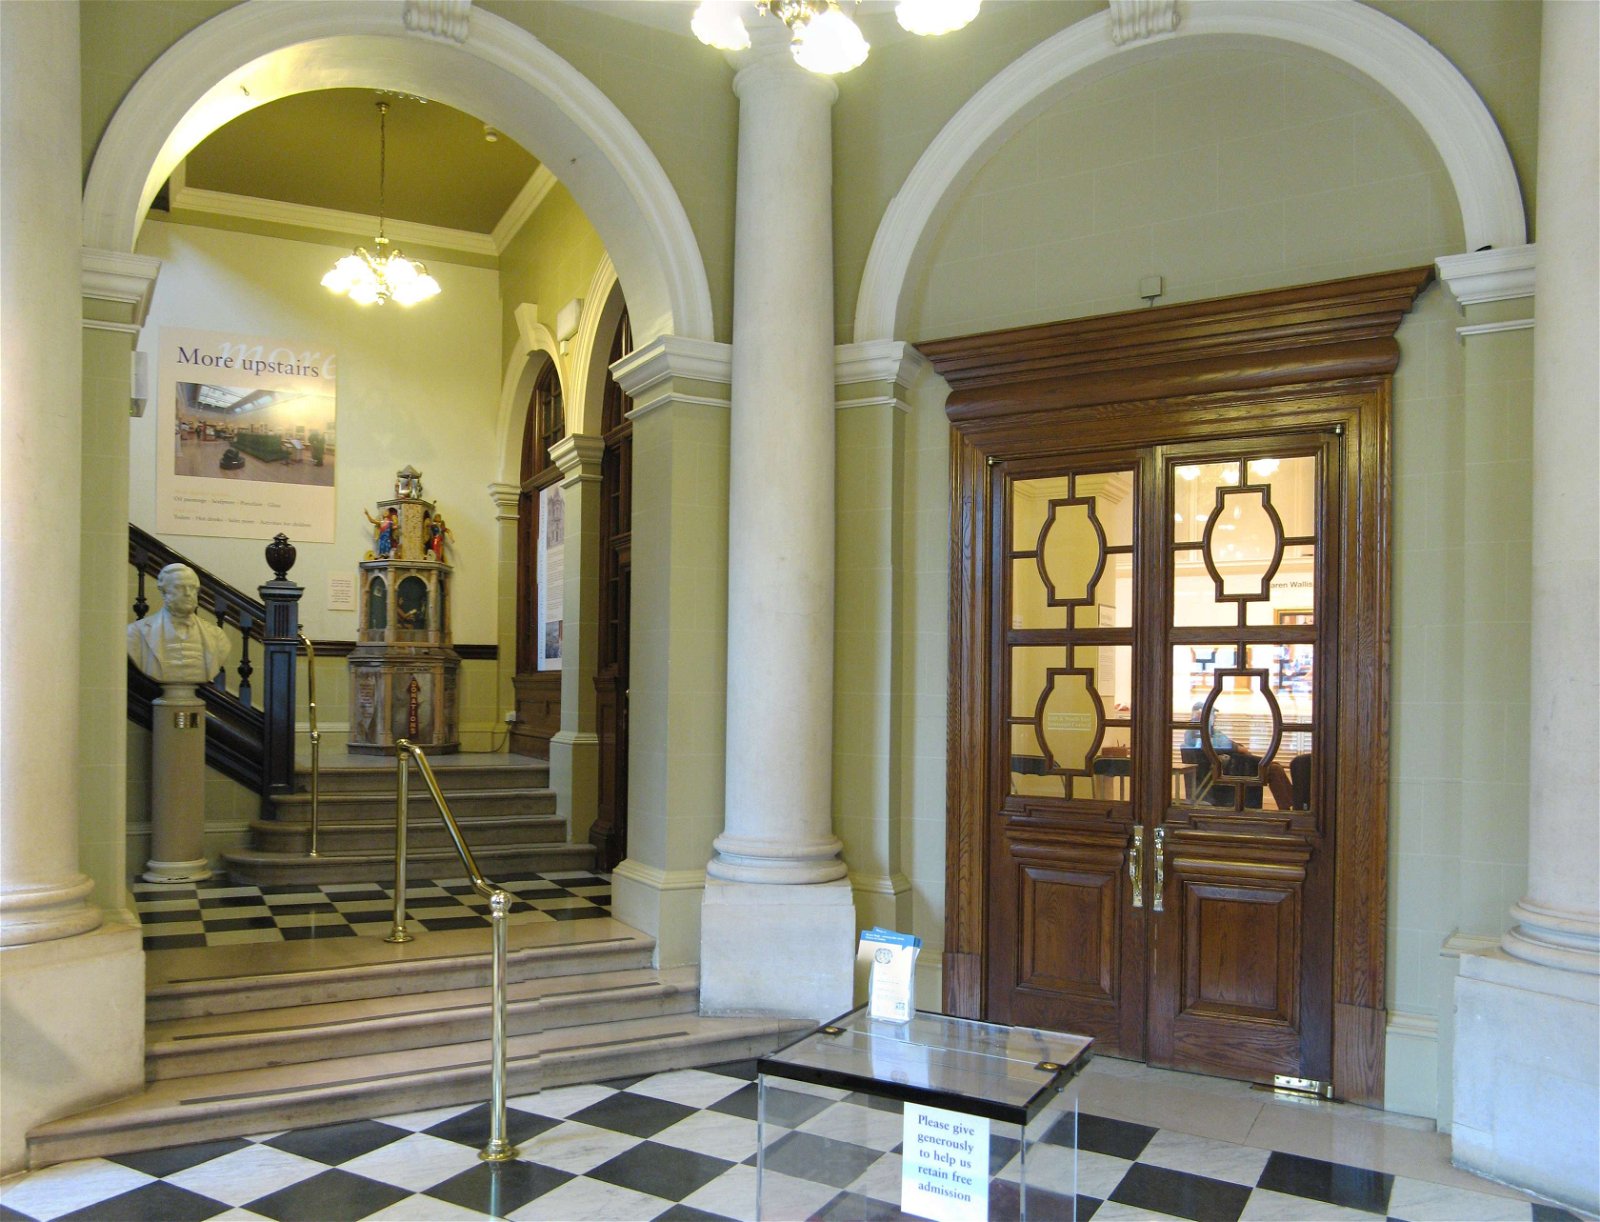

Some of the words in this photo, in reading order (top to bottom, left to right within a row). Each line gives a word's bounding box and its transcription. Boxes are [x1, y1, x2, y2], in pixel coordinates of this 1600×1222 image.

[177, 345, 234, 368] More
[242, 357, 320, 378] upstairs
[409, 680, 418, 734] DONATIONS
[918, 1114, 950, 1130] Please
[952, 1123, 975, 1136] give
[917, 1133, 974, 1154] generously
[919, 1149, 930, 1159] to
[934, 1150, 956, 1166] help
[960, 1159, 972, 1168] us
[918, 1165, 948, 1180] retain
[952, 1171, 973, 1185] free
[918, 1181, 971, 1202] admission
